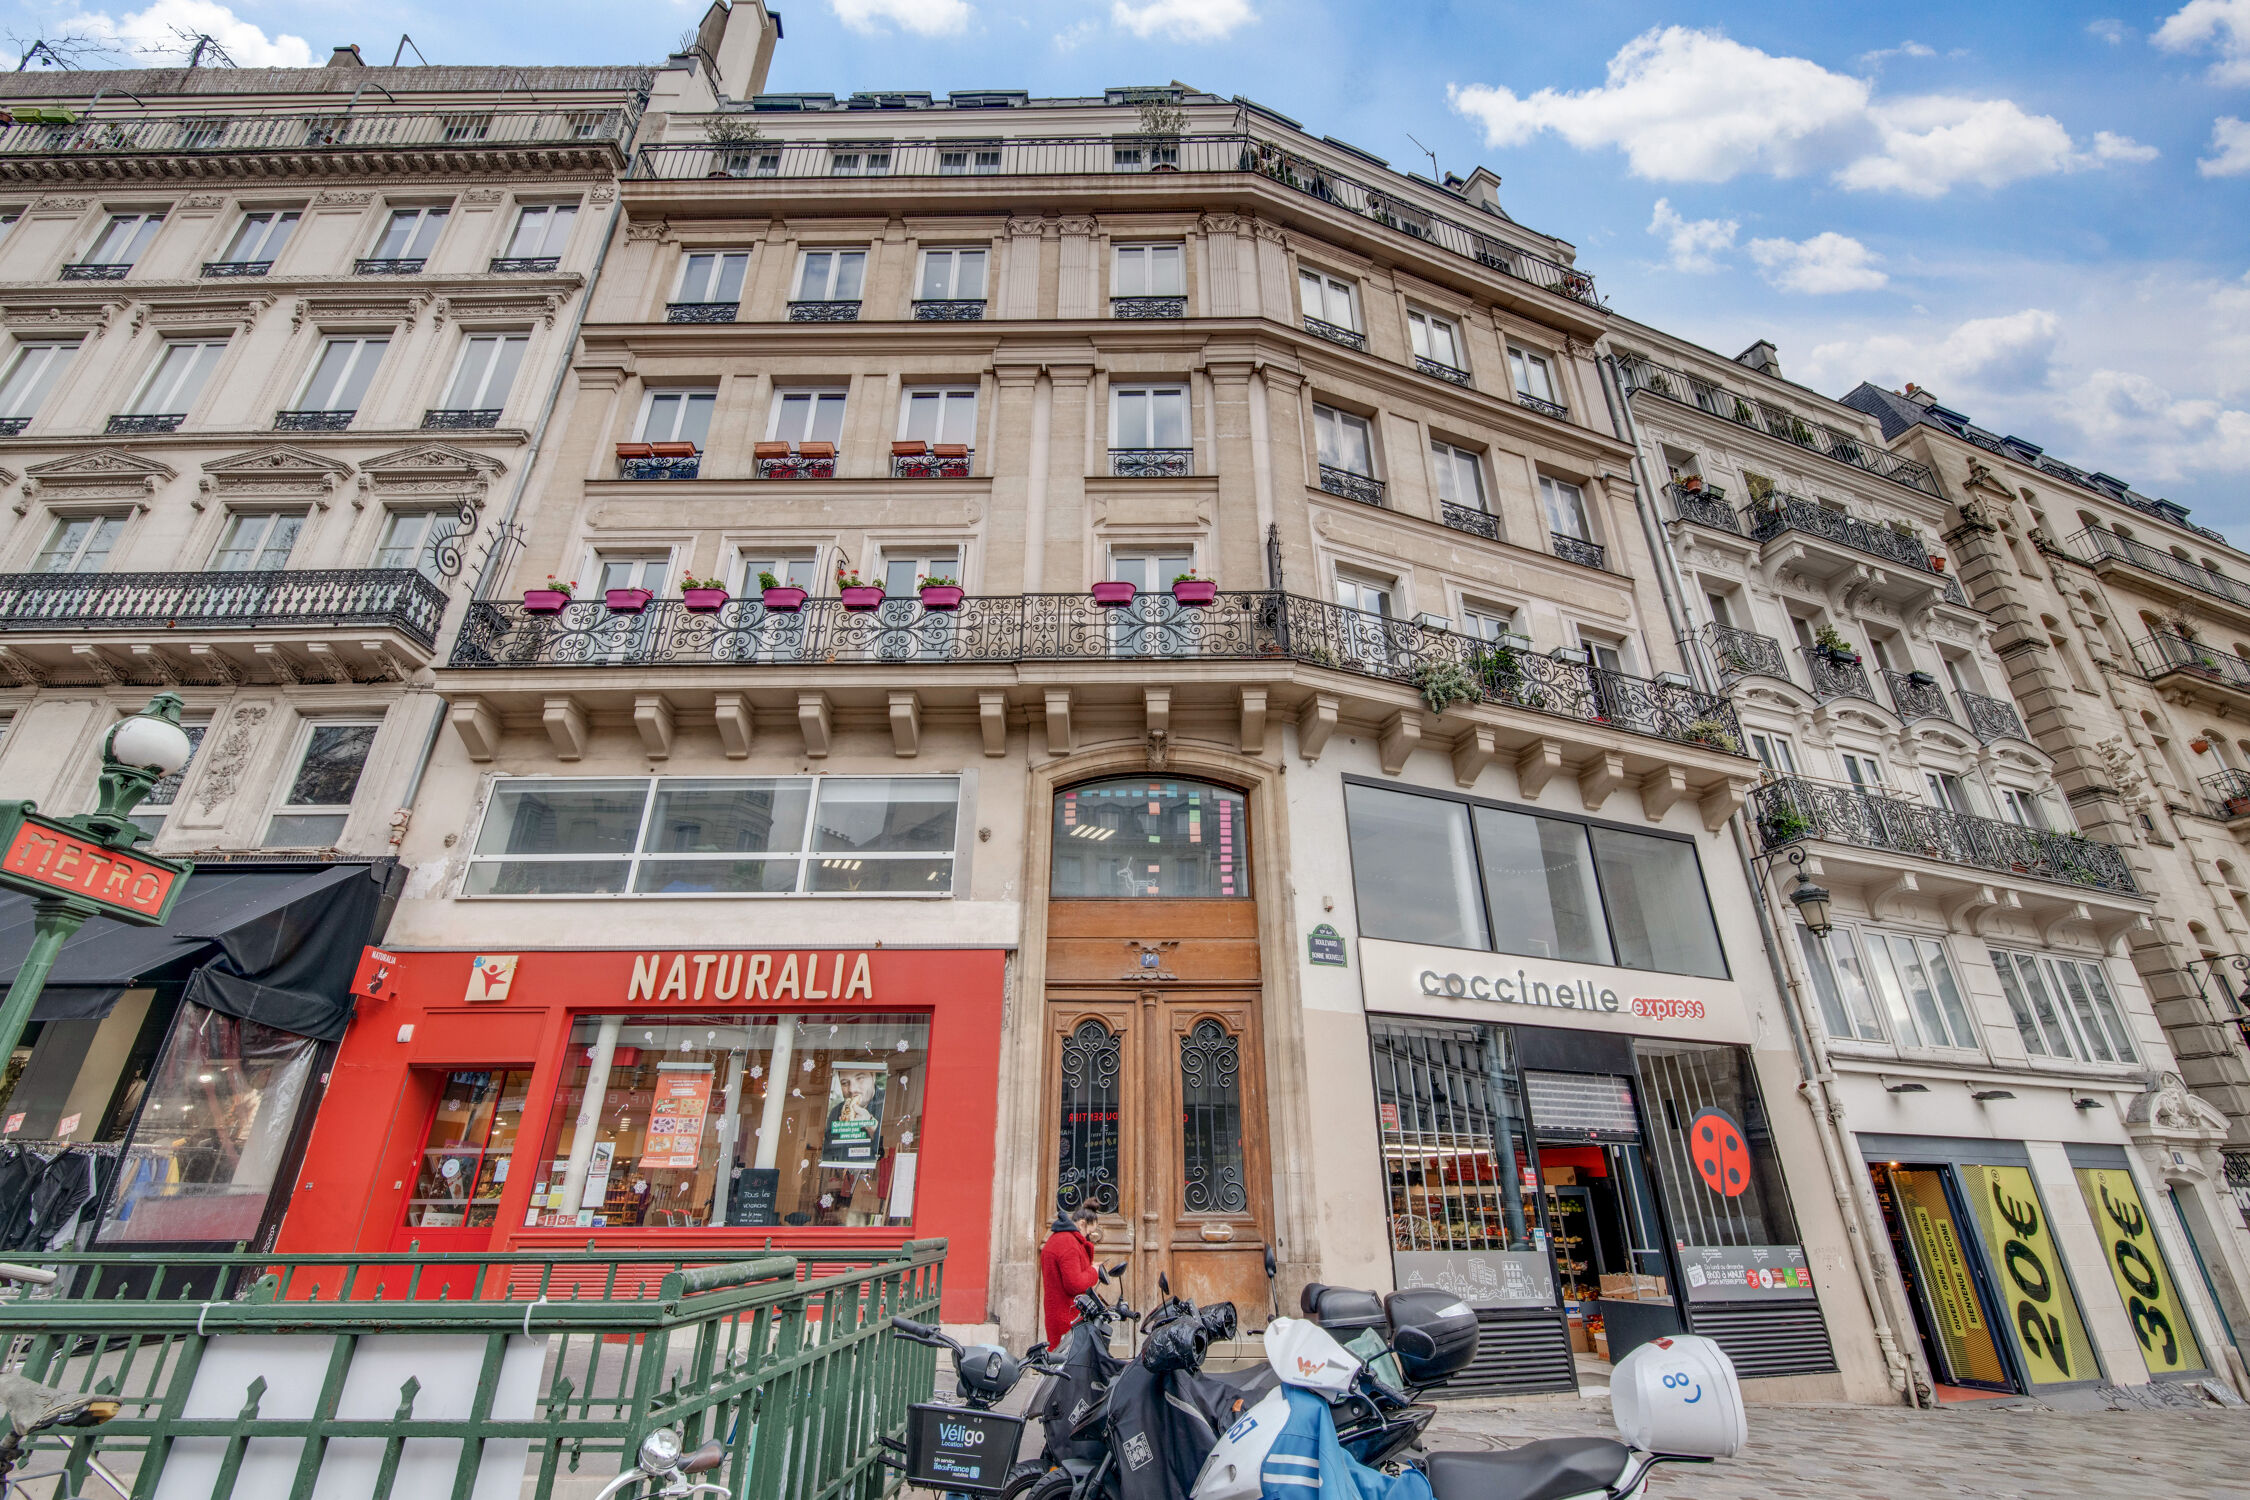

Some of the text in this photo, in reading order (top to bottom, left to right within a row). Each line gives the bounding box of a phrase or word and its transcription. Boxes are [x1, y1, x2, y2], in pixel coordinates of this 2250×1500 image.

[16, 832, 161, 905] METRO
[371, 950, 397, 965] NATURALIA
[627, 953, 873, 1001] NATURALIA
[1419, 969, 1705, 1020] coccinelle express
[1940, 1223, 1958, 1265] WELCOME
[1939, 1269, 1948, 1290] OPEN
[1956, 1273, 1977, 1323] BIENVENUE
[1947, 1298, 1961, 1330] OUVERT
[939, 1423, 985, 1447] Véligo
